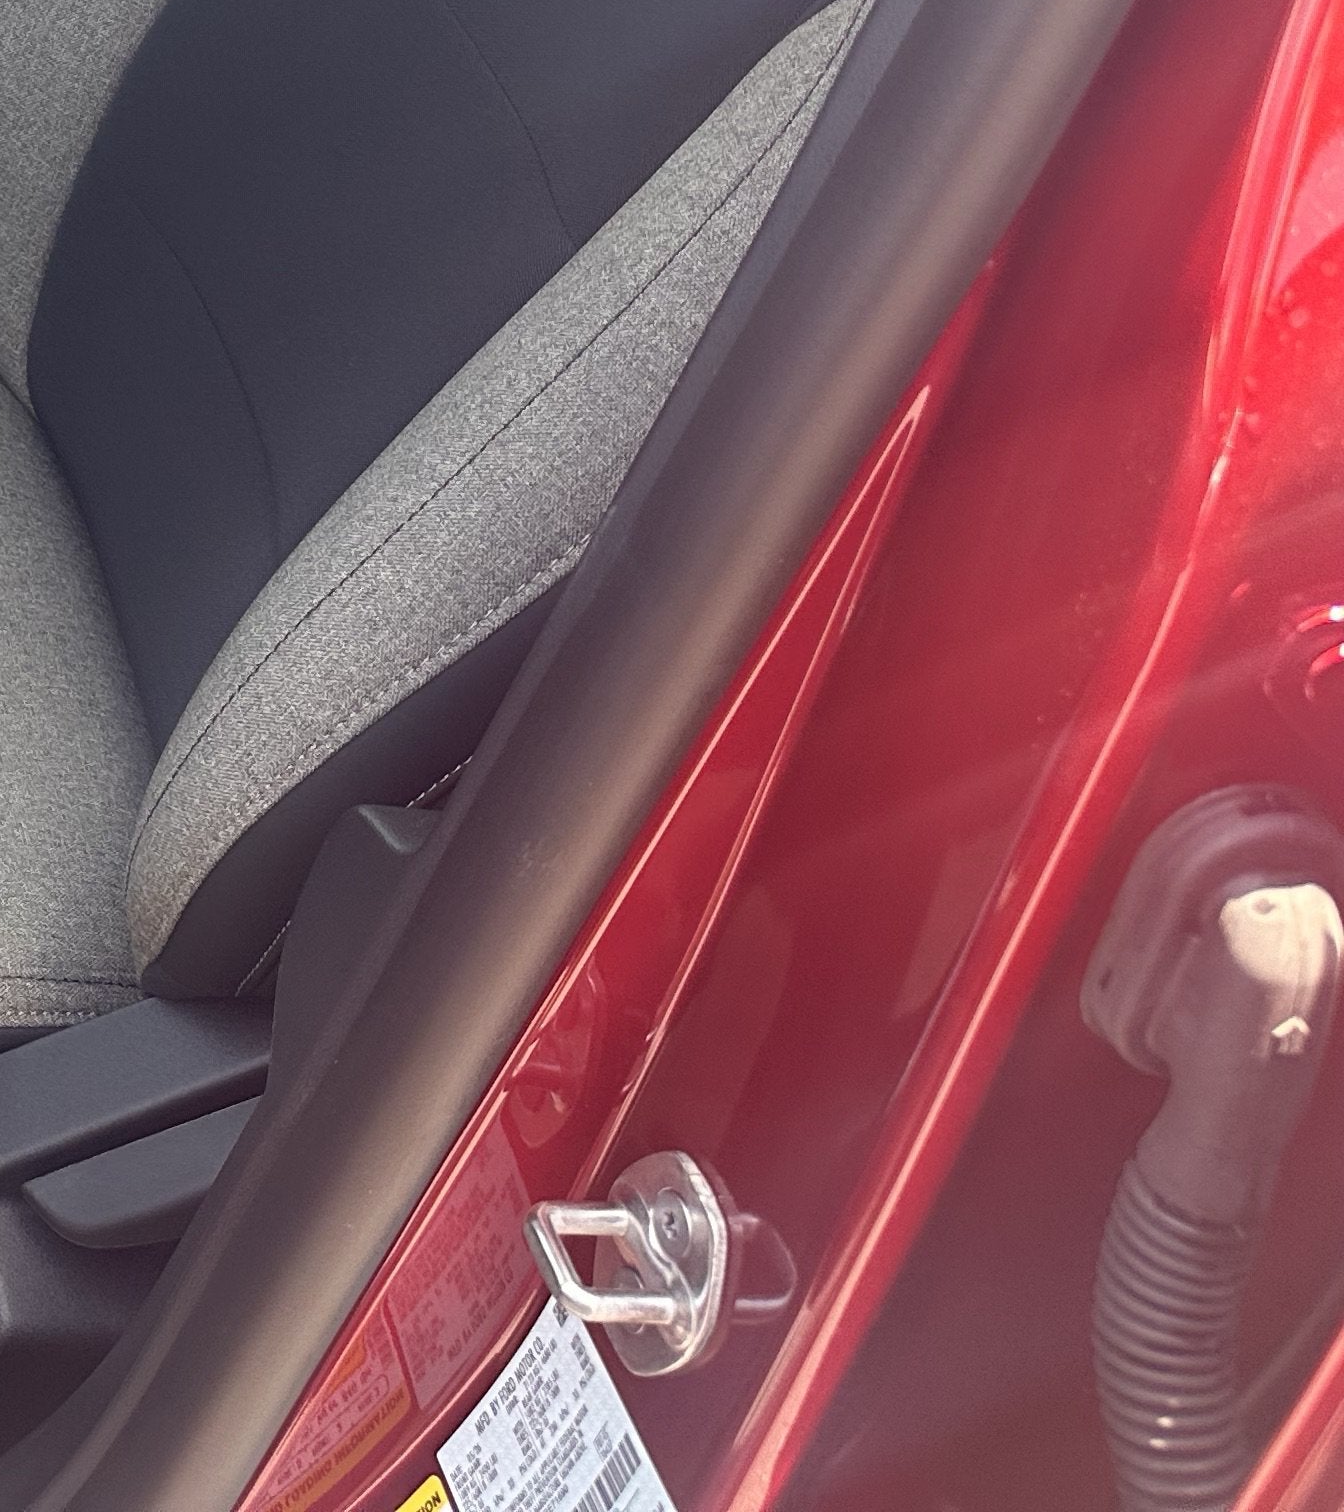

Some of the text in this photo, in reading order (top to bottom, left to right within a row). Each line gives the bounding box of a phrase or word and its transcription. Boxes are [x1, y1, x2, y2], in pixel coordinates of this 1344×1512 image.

[488, 1395, 502, 1416] BY
[496, 1375, 517, 1405] FORD
[511, 1347, 537, 1383] MOTOR
